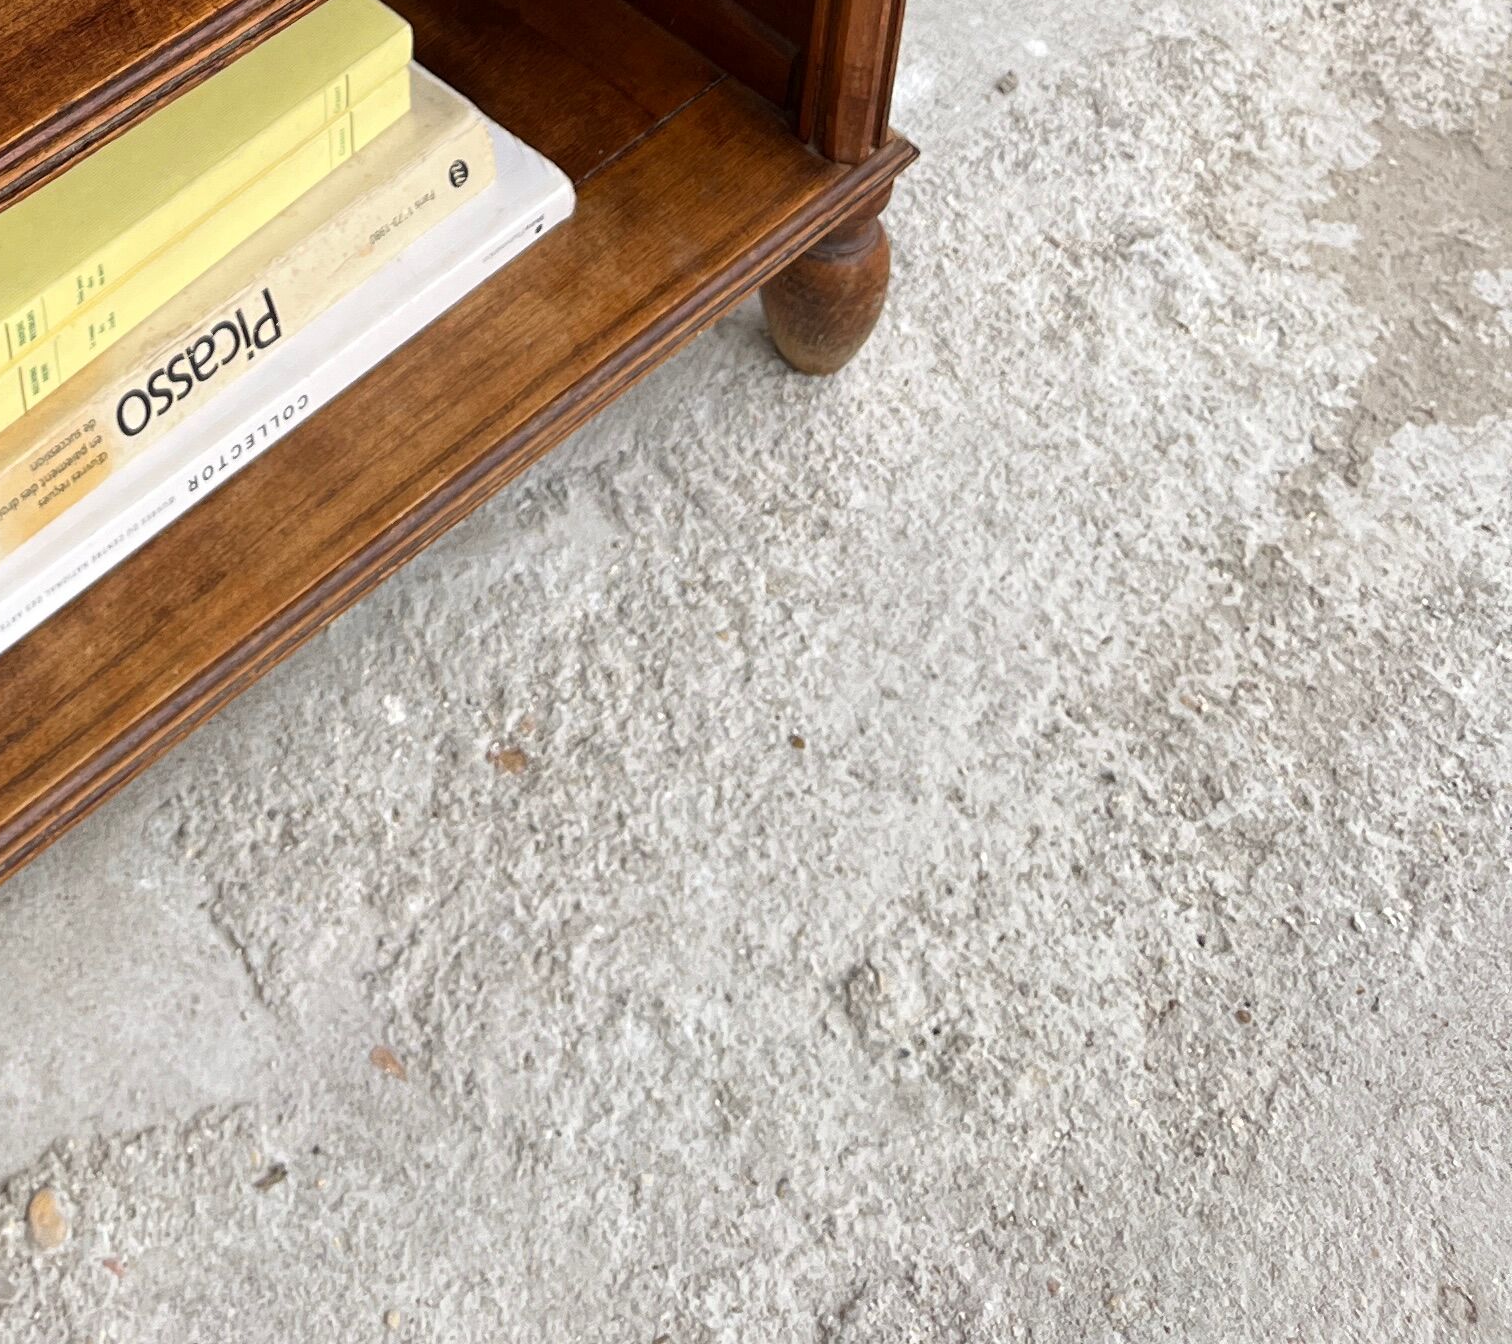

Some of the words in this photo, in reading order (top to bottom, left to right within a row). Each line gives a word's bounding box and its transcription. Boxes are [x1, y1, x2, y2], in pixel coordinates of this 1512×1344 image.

[116, 286, 283, 438] Picasso
[82, 418, 97, 433] de
[89, 434, 103, 450] en
[187, 394, 310, 493] COLLECTOR
[28, 428, 82, 472] succession
[40, 445, 89, 488] paiement
[19, 483, 39, 502] des
